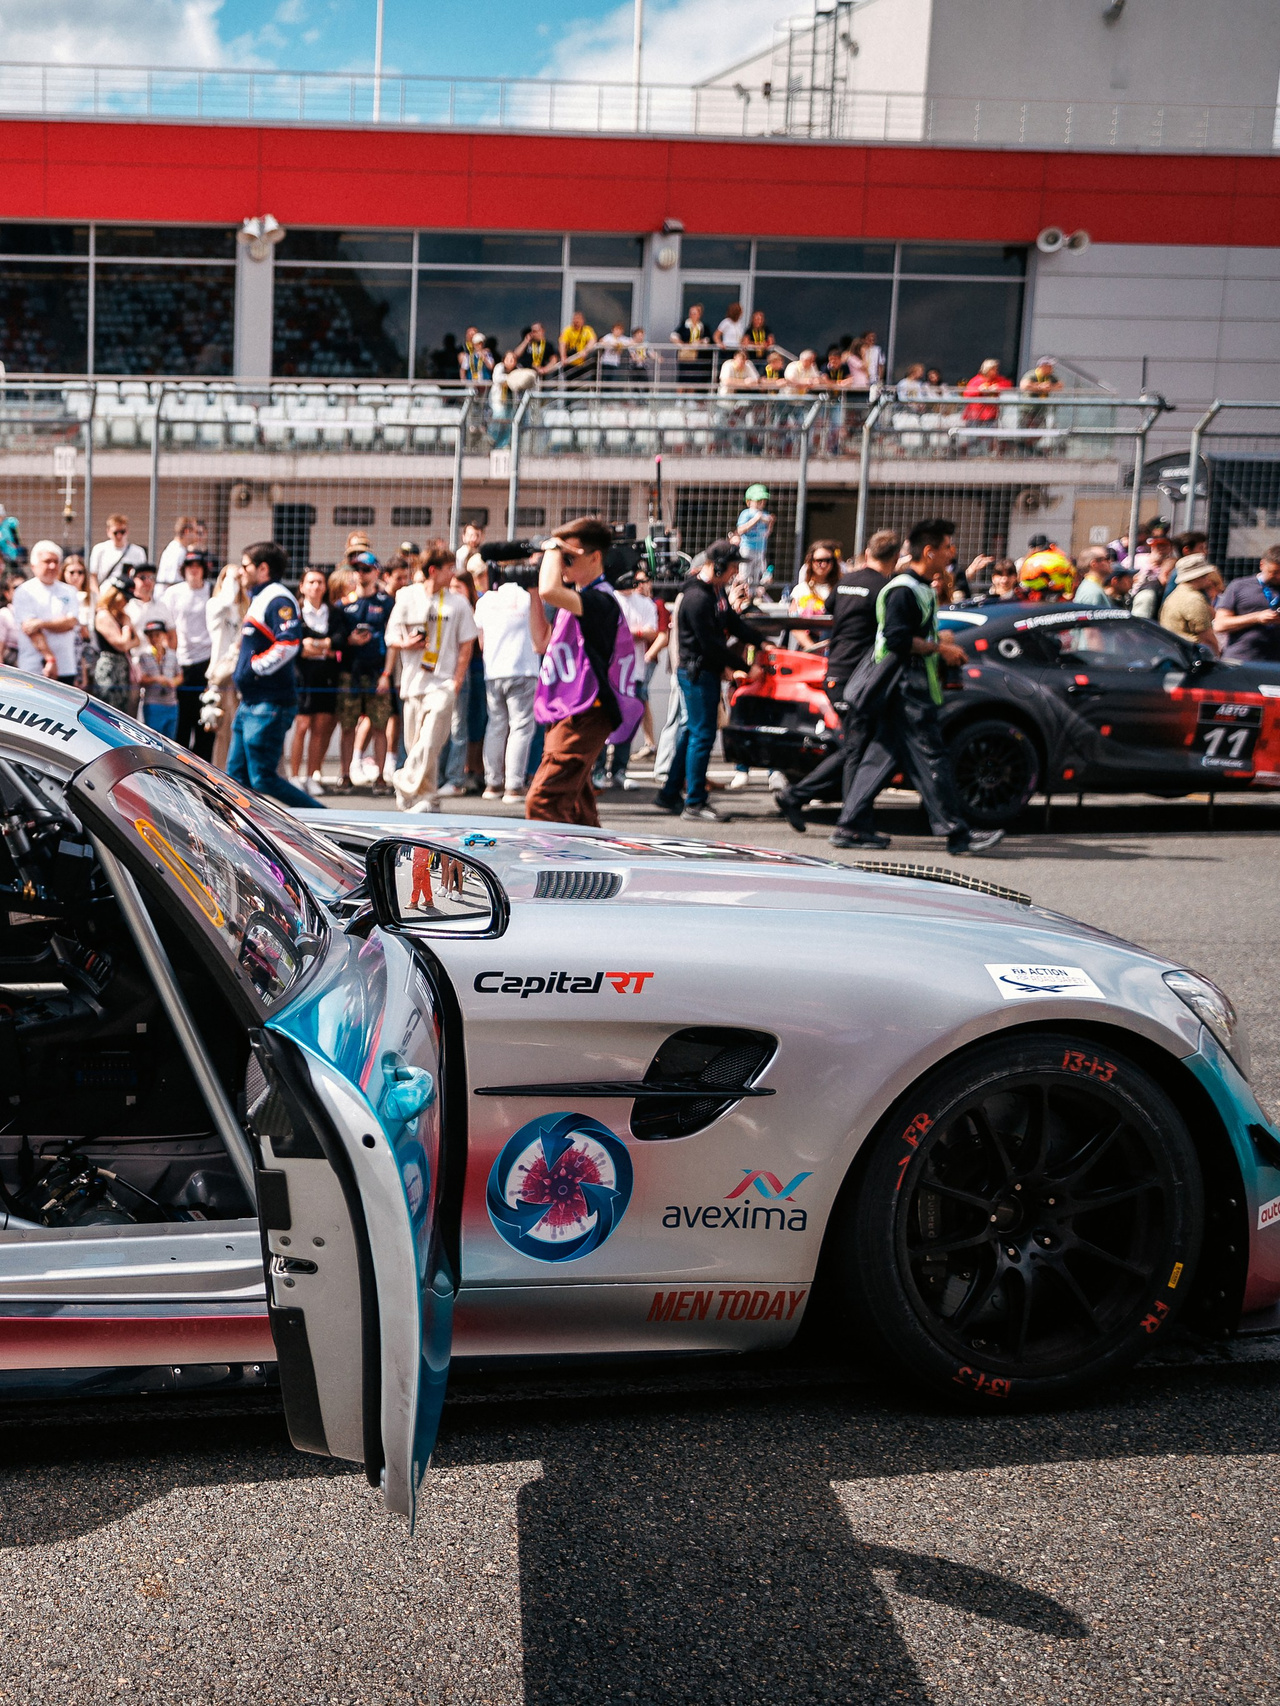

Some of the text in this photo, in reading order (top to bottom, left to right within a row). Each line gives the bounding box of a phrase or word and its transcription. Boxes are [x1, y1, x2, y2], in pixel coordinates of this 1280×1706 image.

[1203, 727, 1249, 758] 11
[1029, 967, 1068, 977] ACTION
[902, 1112, 934, 1147] FR
[662, 1199, 808, 1232] avexima
[646, 1289, 807, 1322] MEN TODAY
[1140, 1300, 1170, 1334] FR
